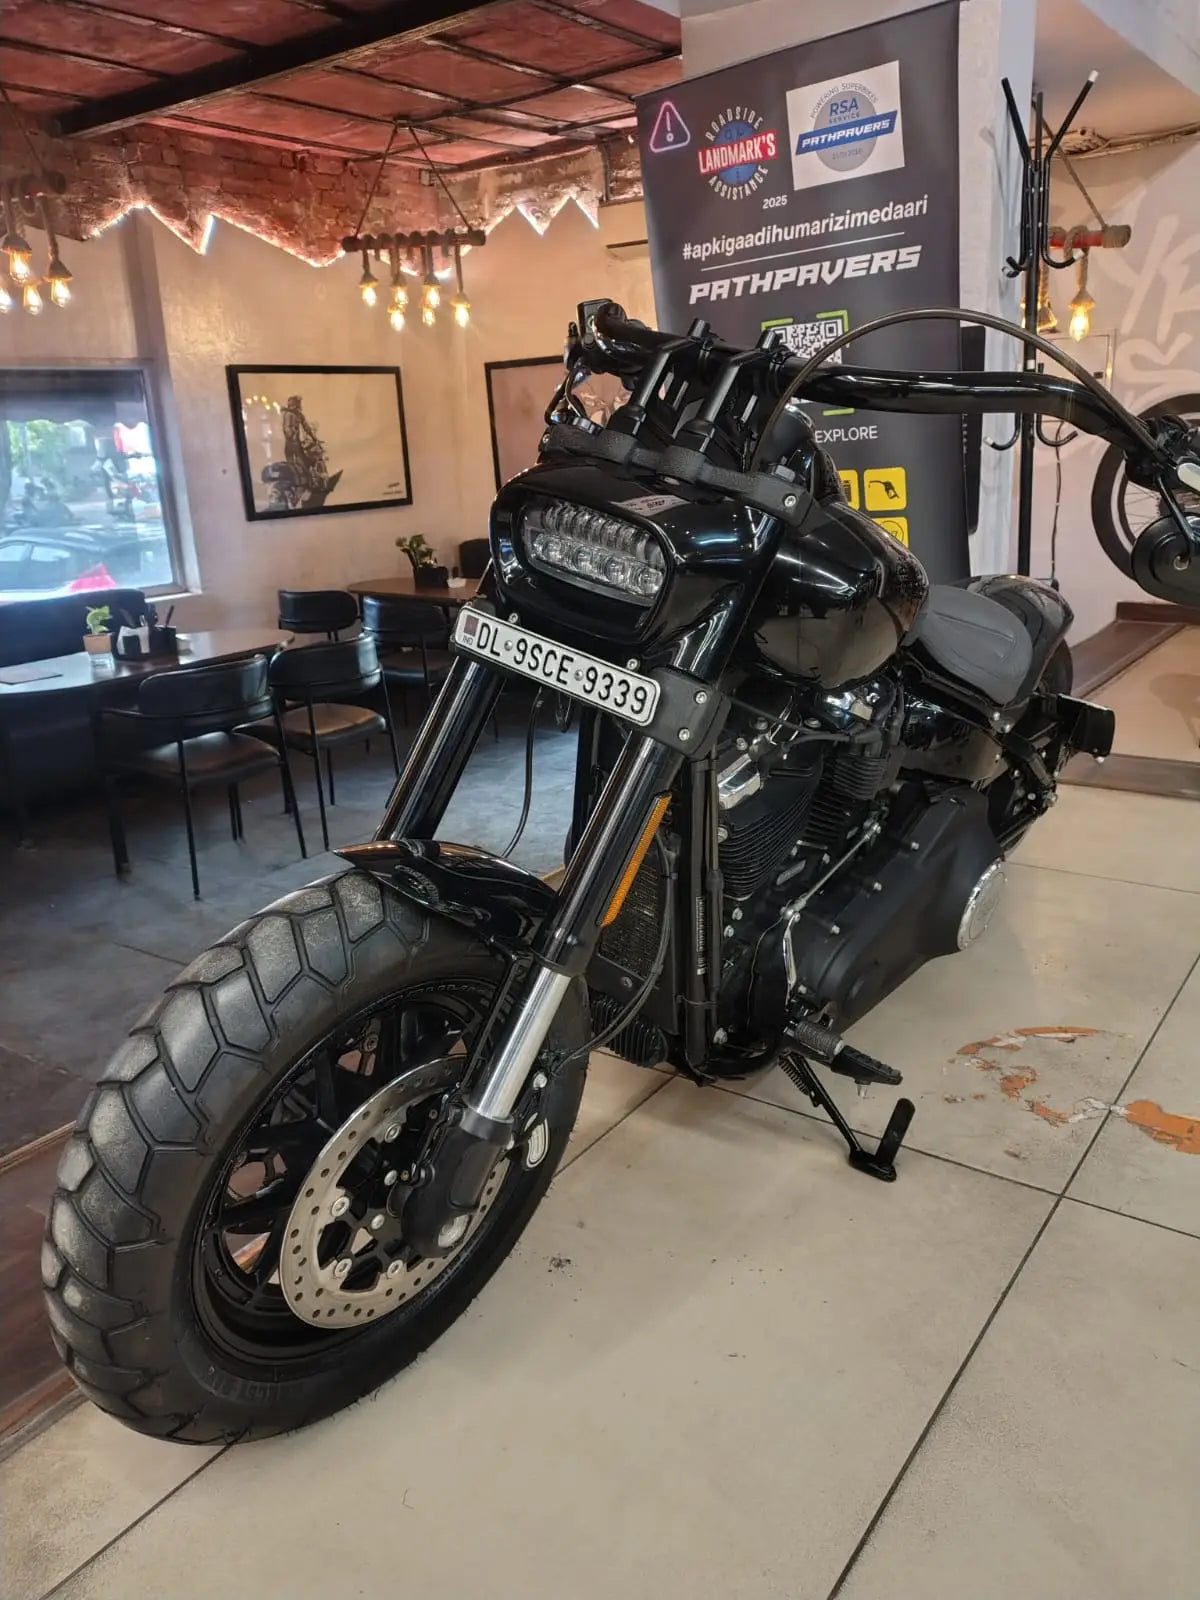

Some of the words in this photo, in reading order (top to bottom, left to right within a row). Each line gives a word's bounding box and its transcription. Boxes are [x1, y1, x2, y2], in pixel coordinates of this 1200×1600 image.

[705, 106, 764, 142] ROADSIDE
[828, 111, 860, 124] SERVICE
[829, 98, 859, 117] RSA
[802, 118, 891, 148] PATHPAVERS
[698, 132, 776, 174] LANDMARK'S
[708, 165, 769, 201] ASSISTANCE
[762, 194, 788, 209] 2025
[682, 194, 928, 262] #apkigaadihumarizimedaari
[689, 245, 922, 305] PATHPAVERS
[814, 425, 878, 444] EXPLORE
[476, 622, 501, 657] DL
[513, 637, 574, 686] 9SCE
[582, 666, 648, 715] 9339
